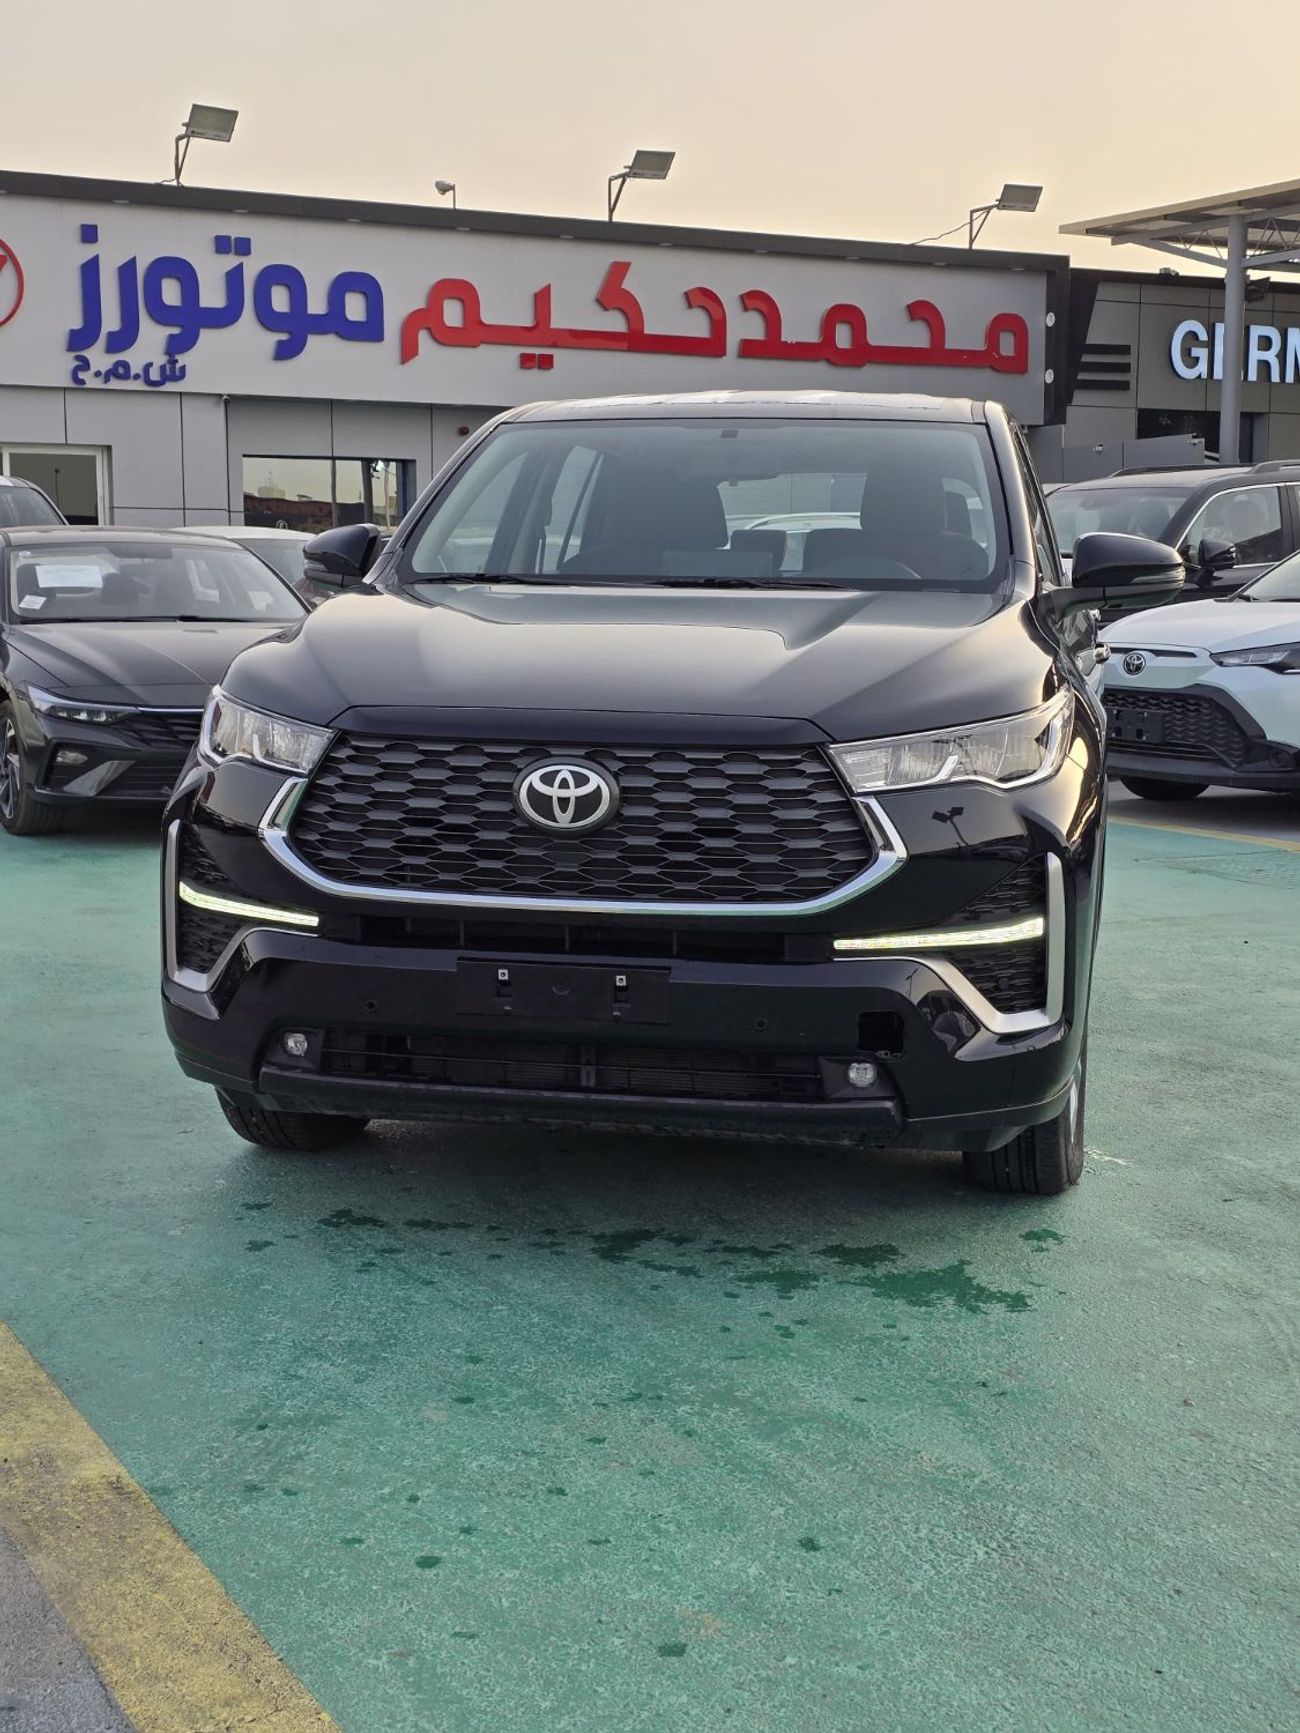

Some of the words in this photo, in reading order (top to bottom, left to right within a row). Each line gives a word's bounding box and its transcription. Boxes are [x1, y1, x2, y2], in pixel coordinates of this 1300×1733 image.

[66, 223, 385, 361] موتورز
[401, 261, 727, 370] حكيم
[738, 290, 1030, 374] محمد
